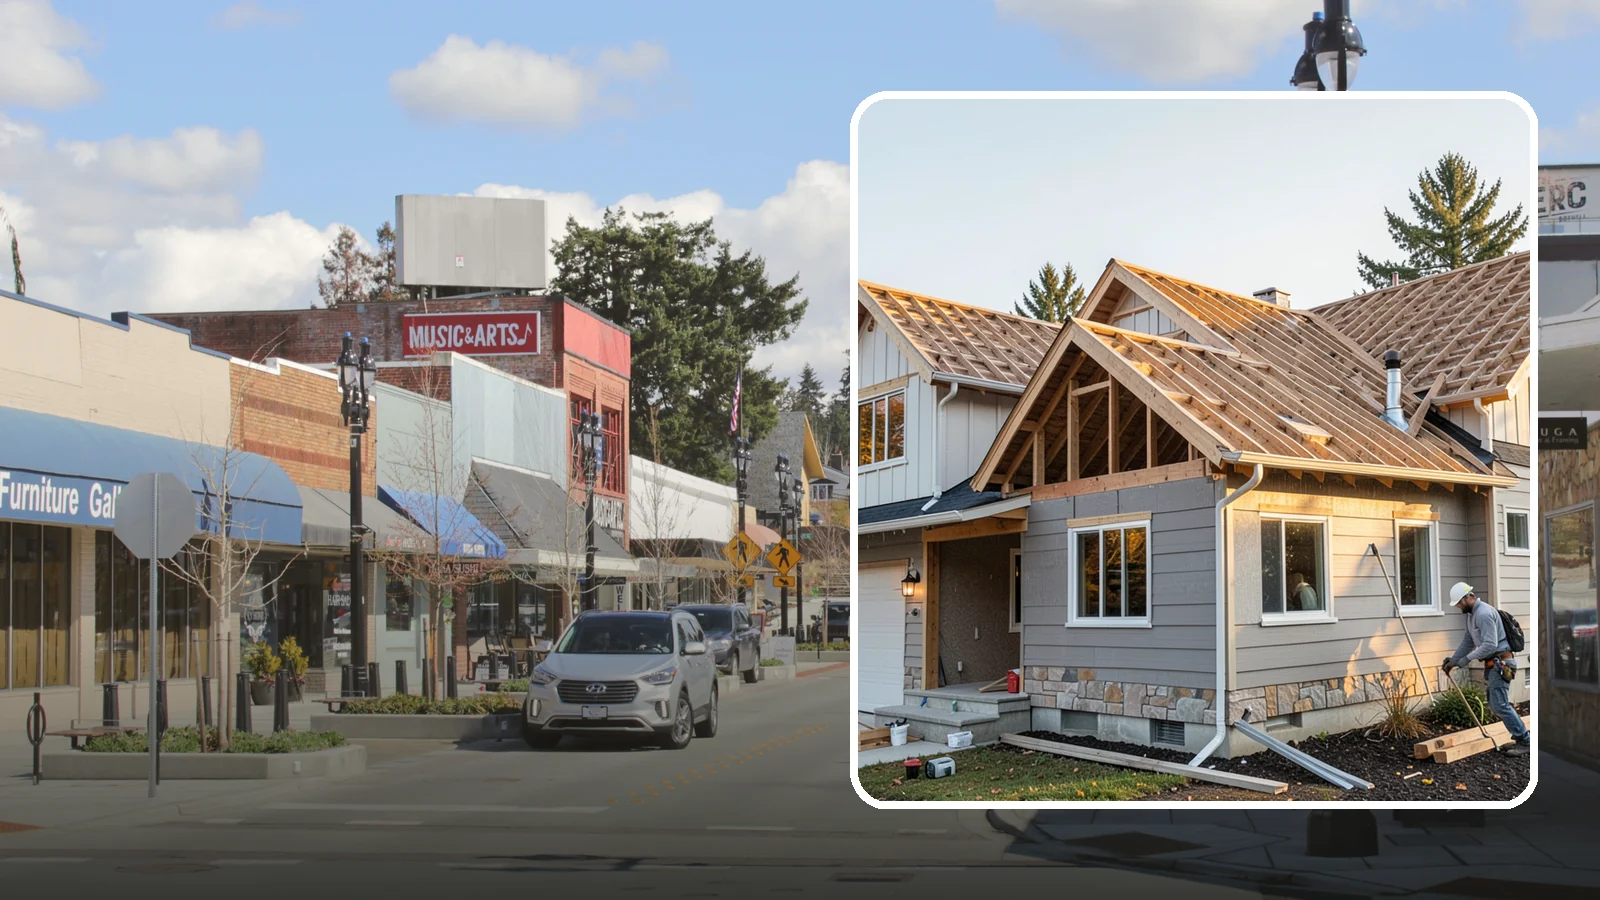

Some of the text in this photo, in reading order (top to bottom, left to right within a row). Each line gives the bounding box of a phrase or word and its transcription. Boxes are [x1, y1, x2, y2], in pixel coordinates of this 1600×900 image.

[1540, 427, 1578, 437] UGA
[0, 471, 122, 519] Furniture Gal
